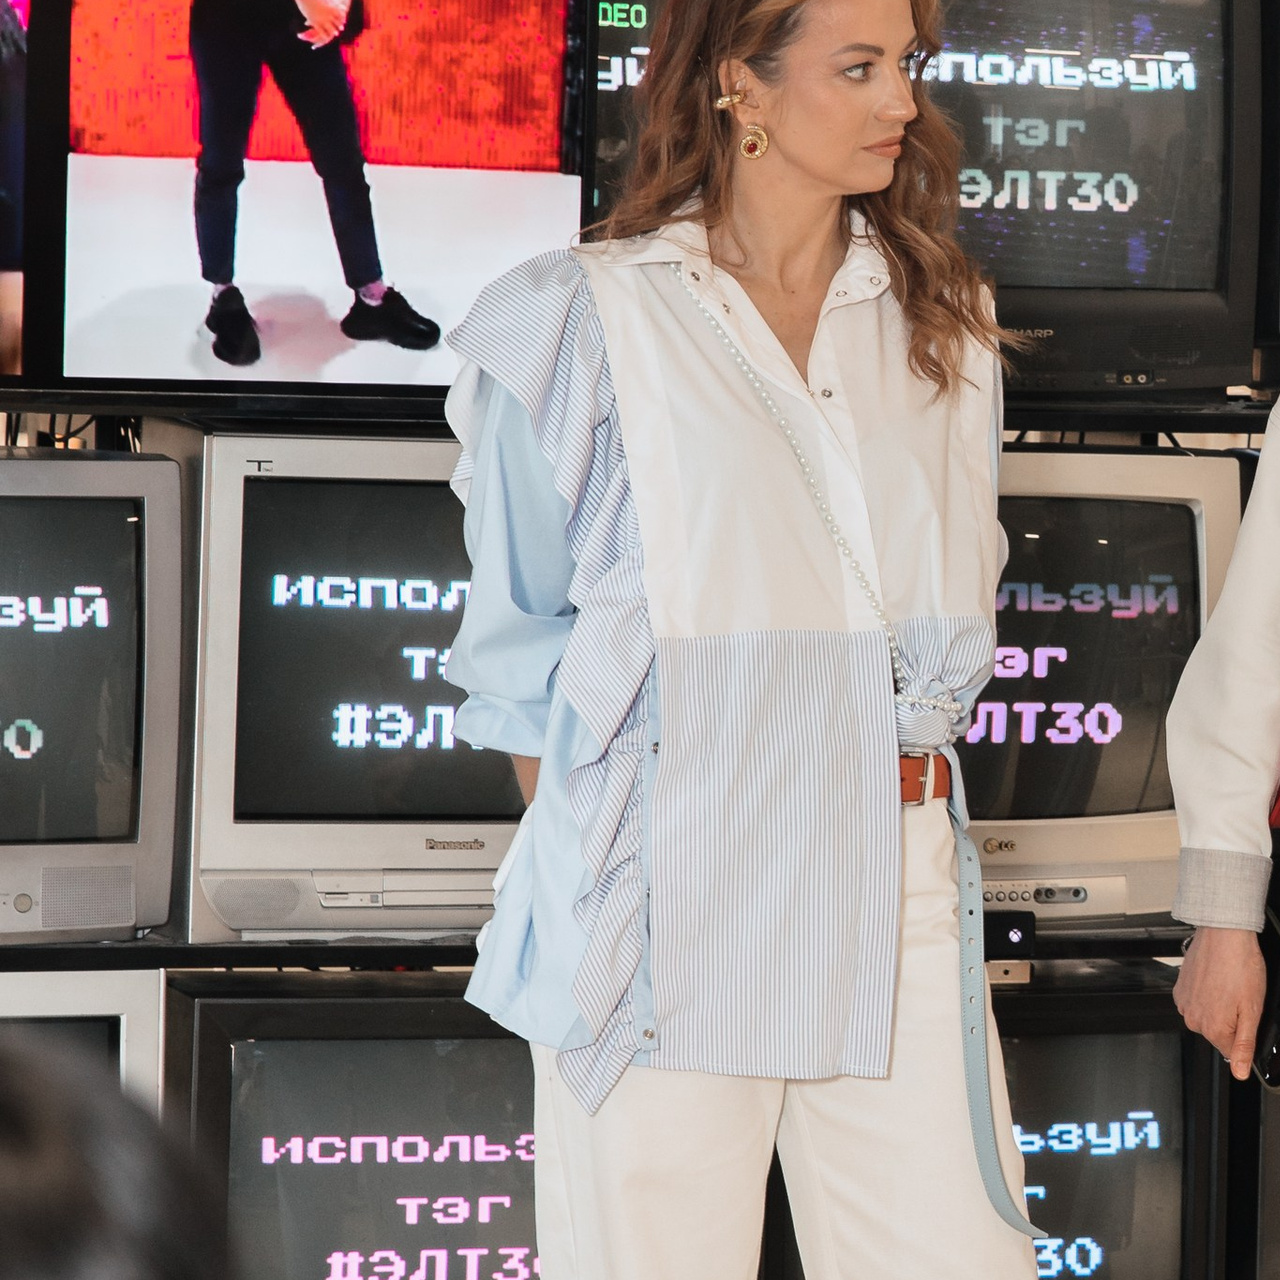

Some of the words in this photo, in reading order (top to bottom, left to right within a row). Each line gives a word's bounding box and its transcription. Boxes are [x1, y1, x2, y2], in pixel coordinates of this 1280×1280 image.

[598, 2, 647, 28] DEO
[958, 168, 1138, 212] ЭЛТ30
[272, 574, 471, 611] испол
[994, 646, 1067, 678] эг
[965, 702, 1122, 744] ЛТ30
[425, 838, 485, 850] Panasonic
[262, 1134, 535, 1164] использ
